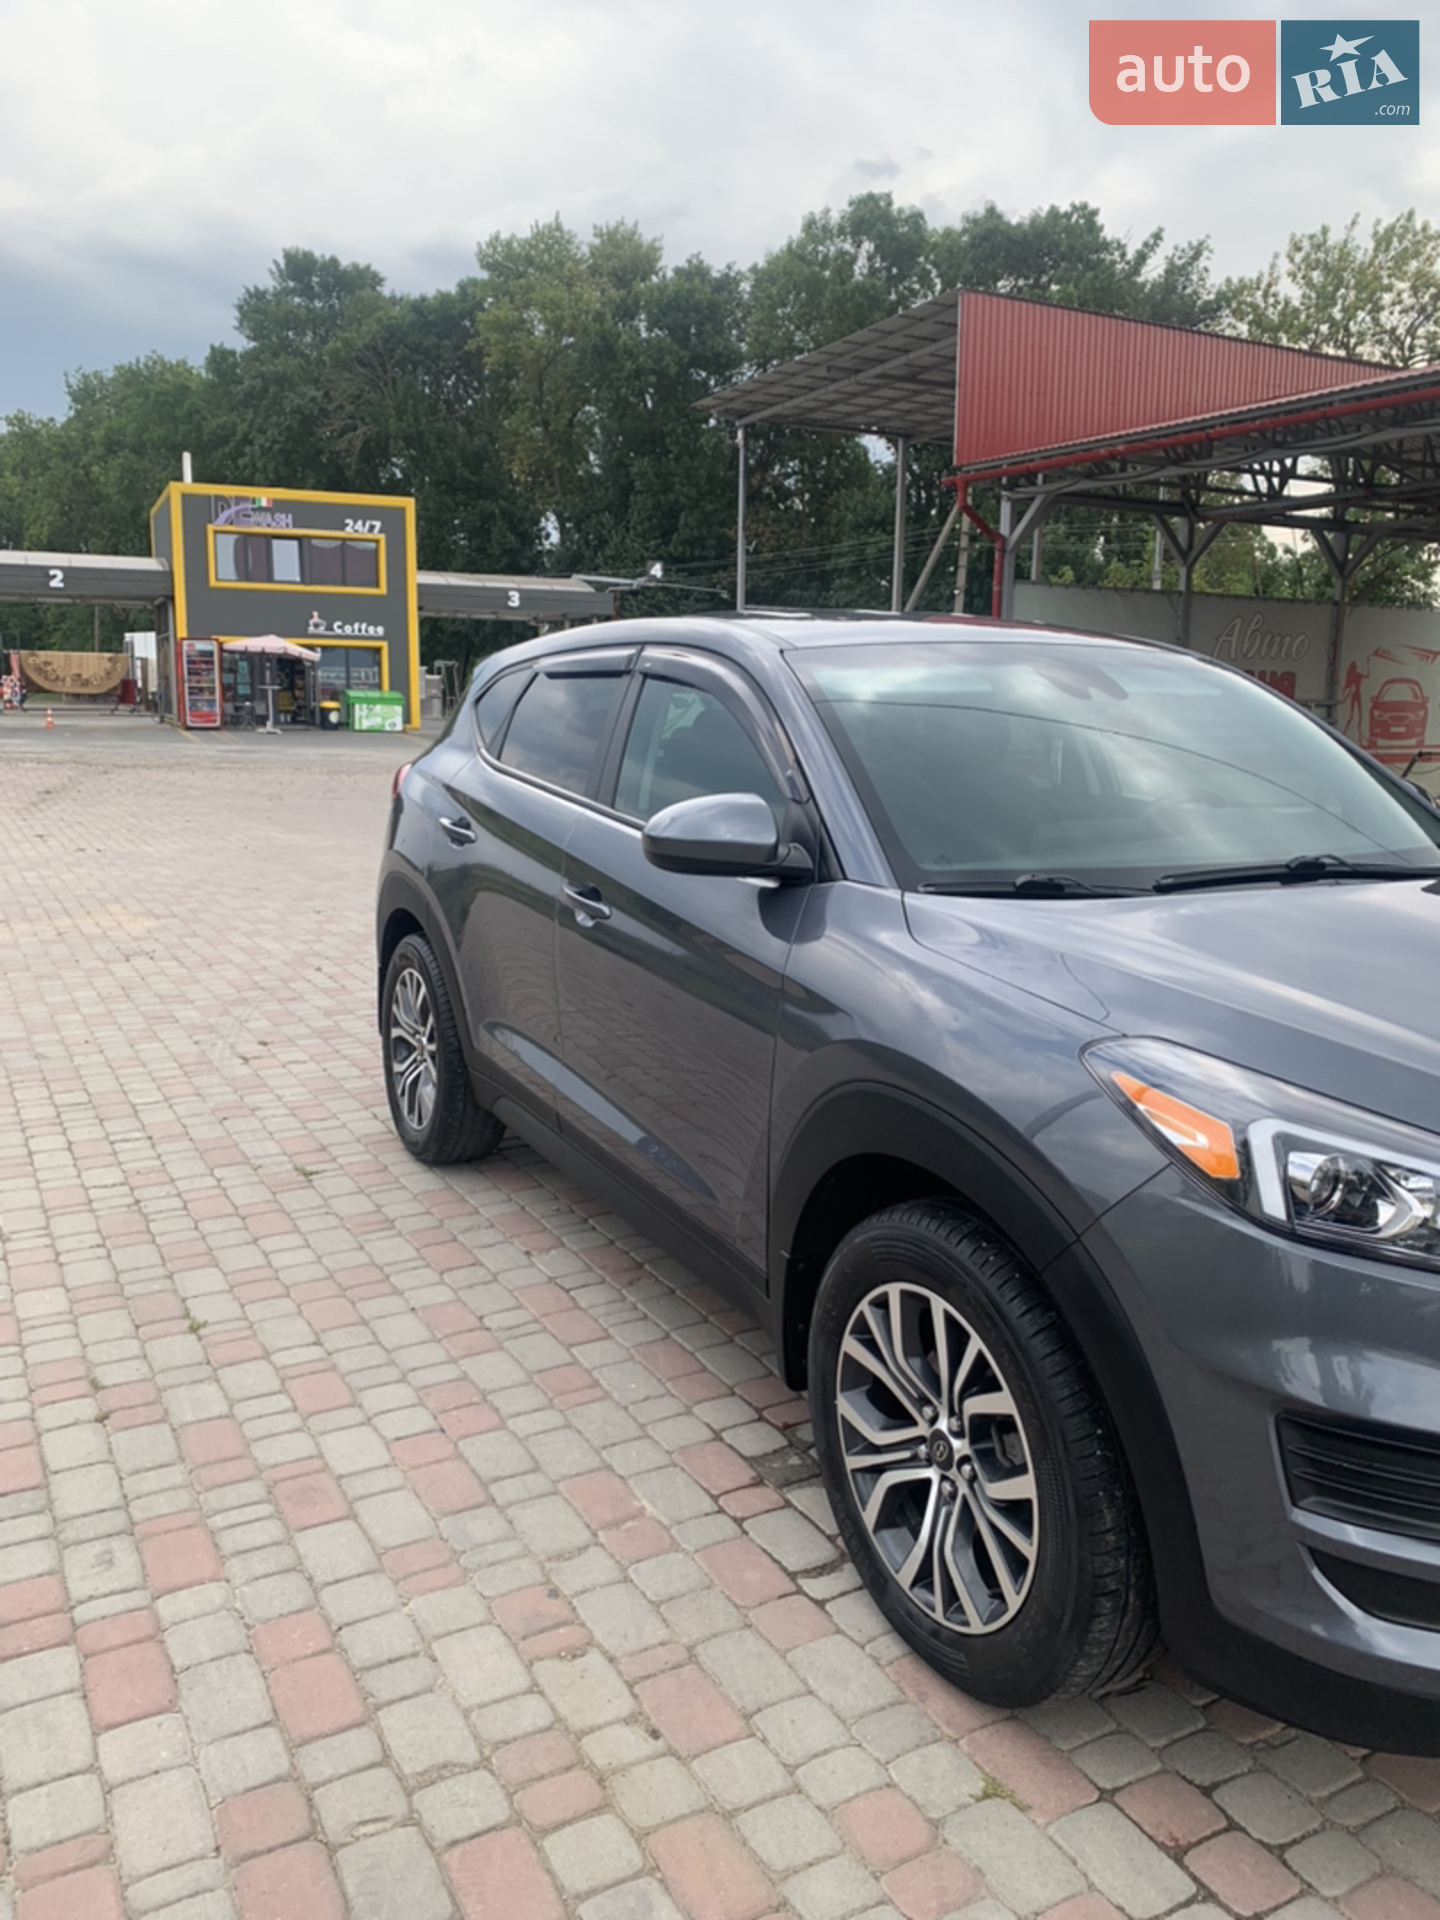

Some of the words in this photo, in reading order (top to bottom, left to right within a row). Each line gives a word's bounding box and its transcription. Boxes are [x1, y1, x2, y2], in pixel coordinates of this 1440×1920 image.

[343, 518, 382, 535] 24/7
[48, 569, 65, 588] 2
[650, 562, 663, 578] 4
[507, 590, 520, 607] 3
[333, 621, 385, 637] Coffee
